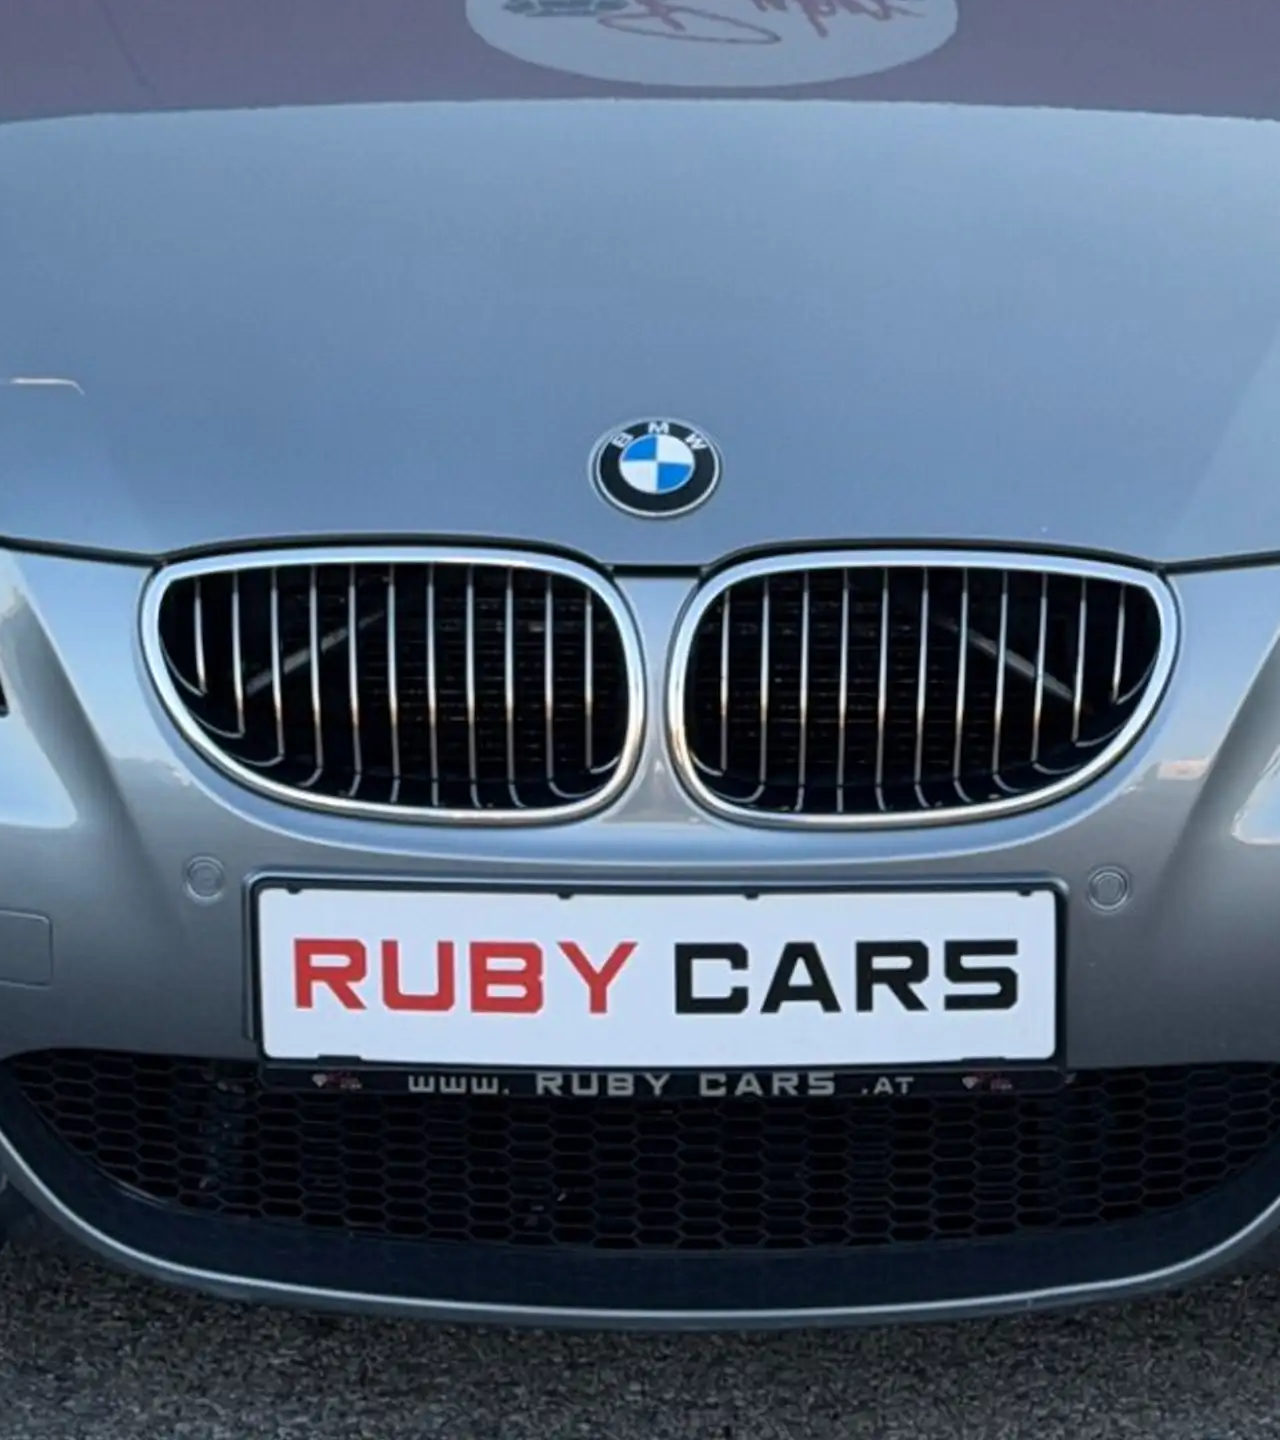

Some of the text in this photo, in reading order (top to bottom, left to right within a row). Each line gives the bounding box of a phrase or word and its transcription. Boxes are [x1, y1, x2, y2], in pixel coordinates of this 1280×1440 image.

[611, 421, 708, 451] BMW
[293, 937, 1020, 1015] RUBY CARS
[535, 1071, 670, 1097] RUBY
[698, 1071, 837, 1097] CARS
